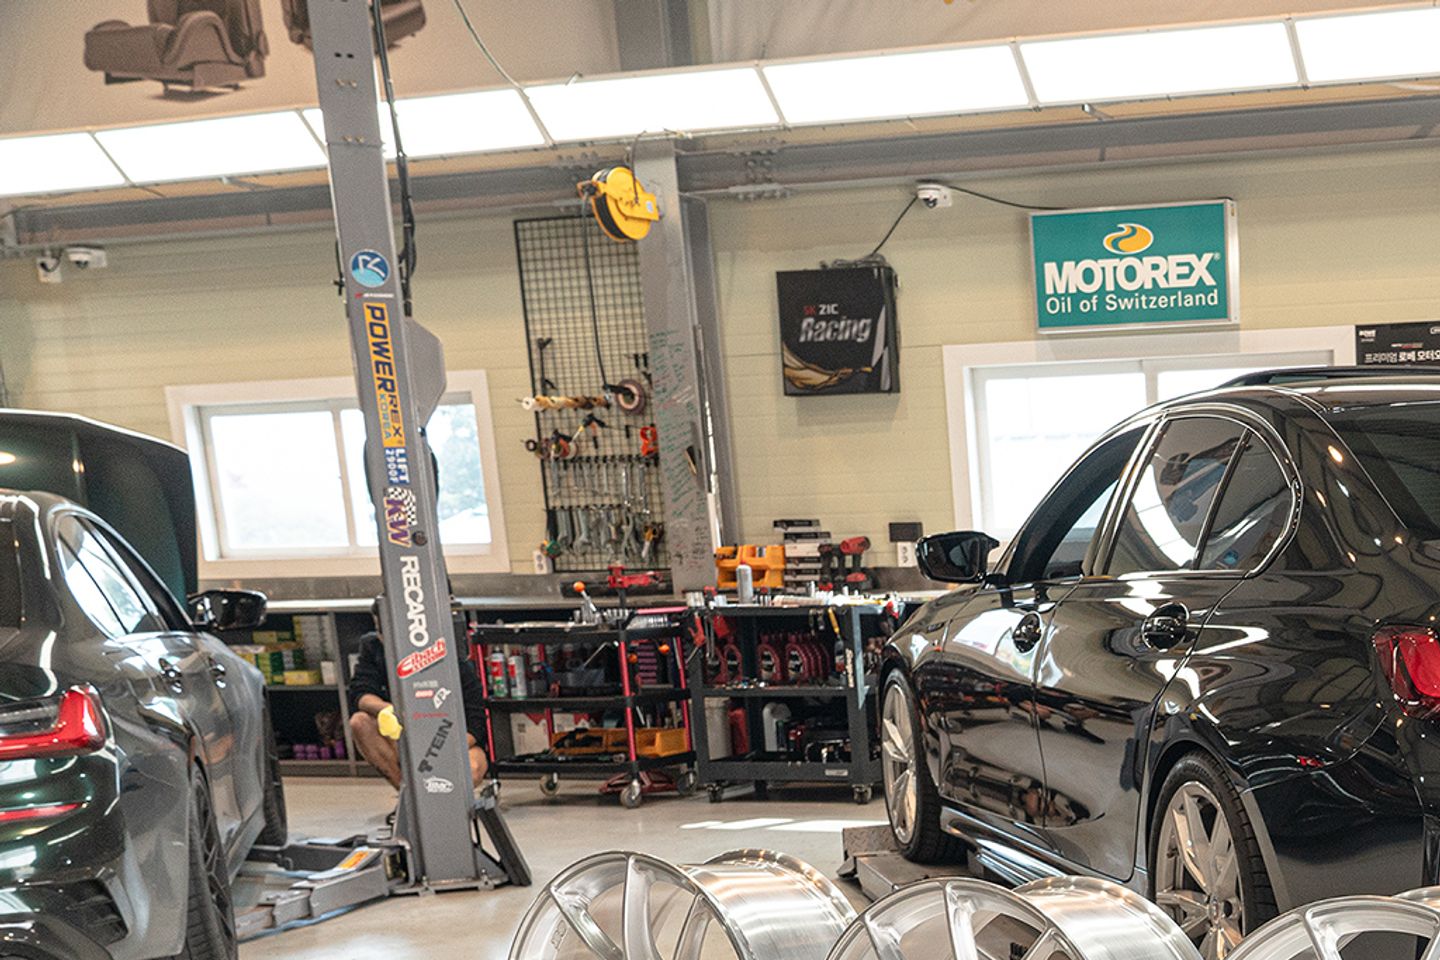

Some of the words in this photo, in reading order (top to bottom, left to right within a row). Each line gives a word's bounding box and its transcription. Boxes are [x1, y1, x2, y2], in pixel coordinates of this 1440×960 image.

[1044, 253, 1217, 294] MOTOREX
[819, 304, 838, 315] ZIC
[1046, 297, 1071, 314] Oil
[1079, 295, 1098, 312] of
[1106, 289, 1218, 312] Switzerland
[799, 316, 872, 342] Racing
[400, 556, 429, 647] RECARO
[425, 718, 454, 758] TEIN
